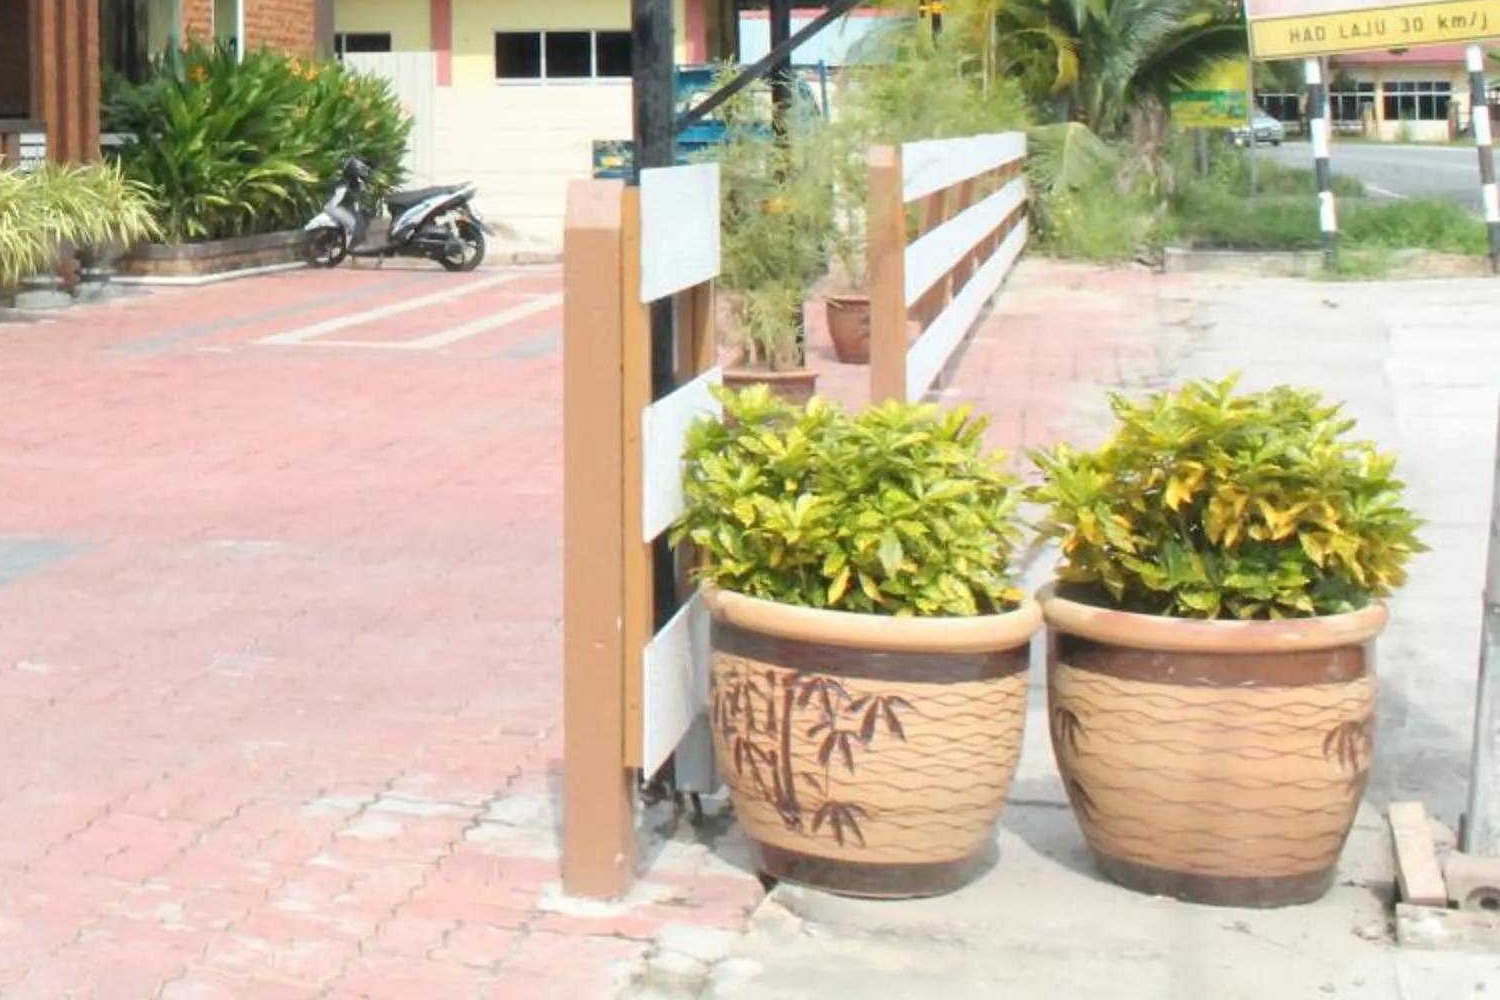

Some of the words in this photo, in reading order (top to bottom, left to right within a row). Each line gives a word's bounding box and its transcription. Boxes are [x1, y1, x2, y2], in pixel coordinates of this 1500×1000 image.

[1289, 25, 1326, 44] HAD
[1339, 18, 1386, 40] LAJU
[1400, 16, 1424, 34] 30
